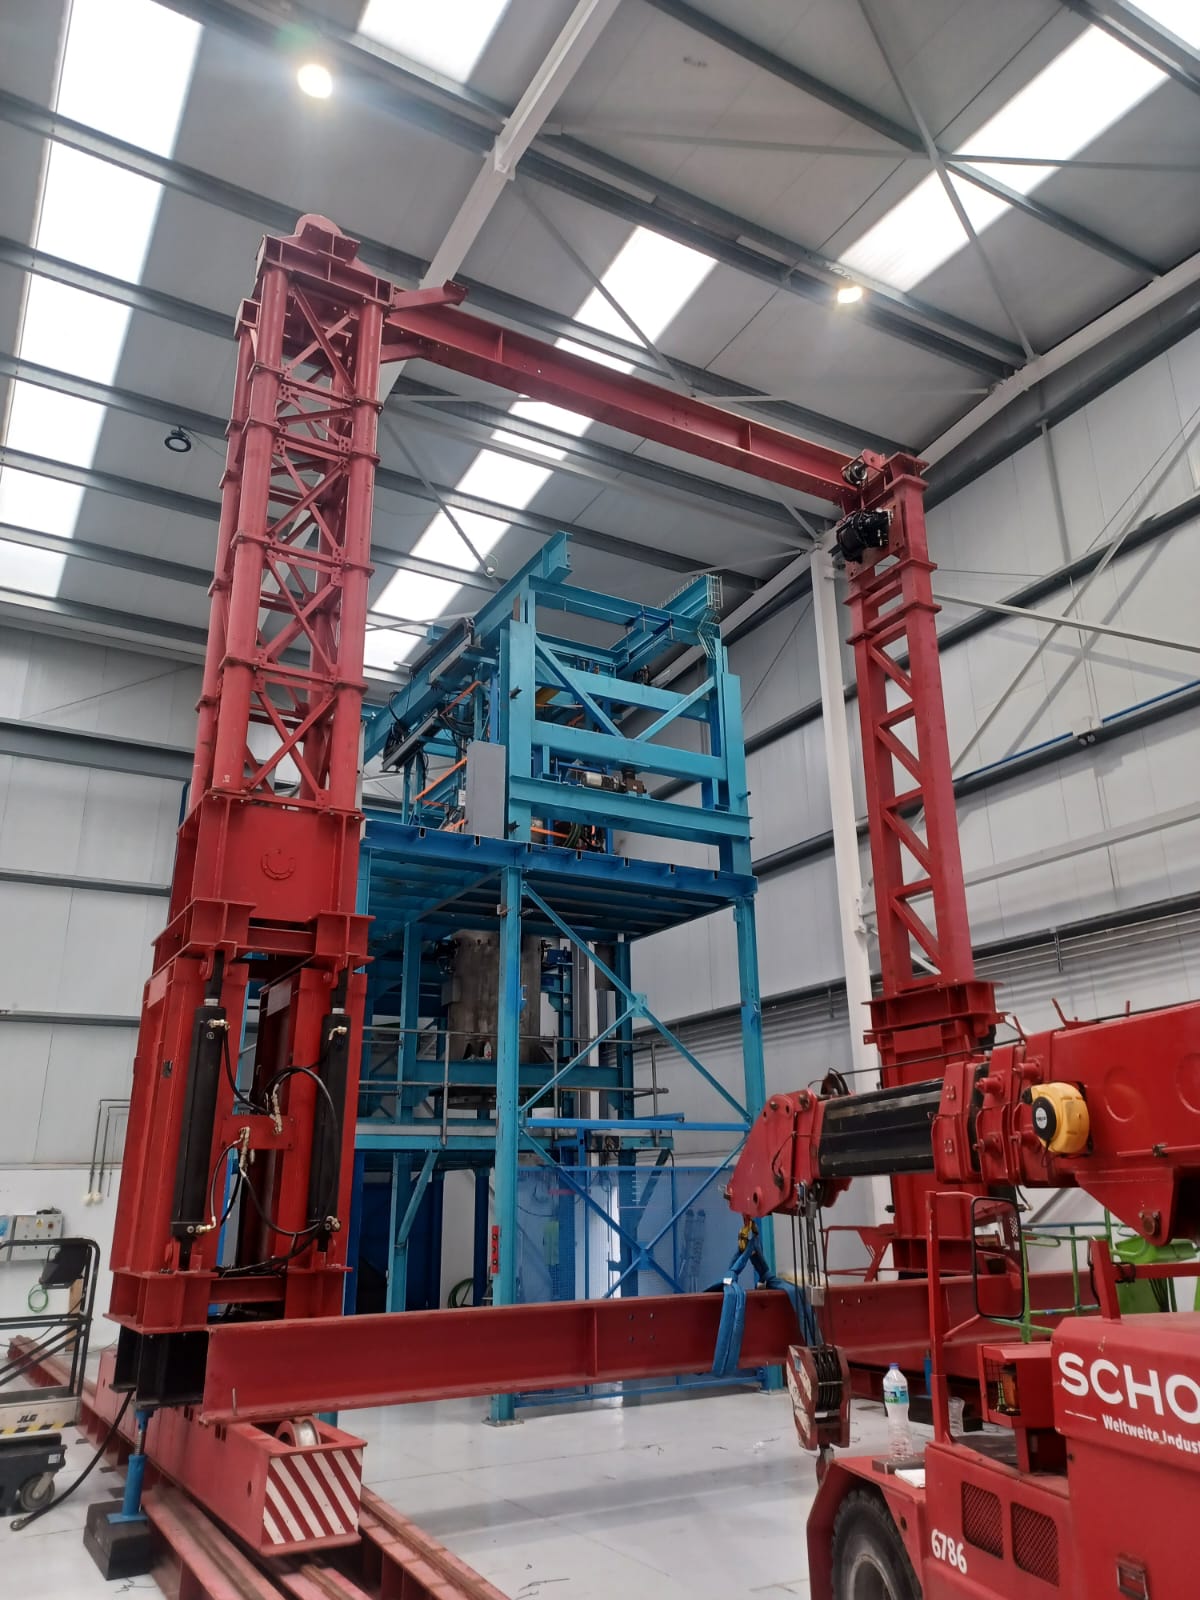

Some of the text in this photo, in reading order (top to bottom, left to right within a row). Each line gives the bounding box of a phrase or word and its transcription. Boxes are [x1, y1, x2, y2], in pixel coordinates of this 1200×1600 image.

[1058, 1352, 1200, 1424] SCHO
[17, 1414, 38, 1424] JLG
[1102, 1413, 1160, 1443] Weltweite
[931, 1528, 968, 1575] 6786
